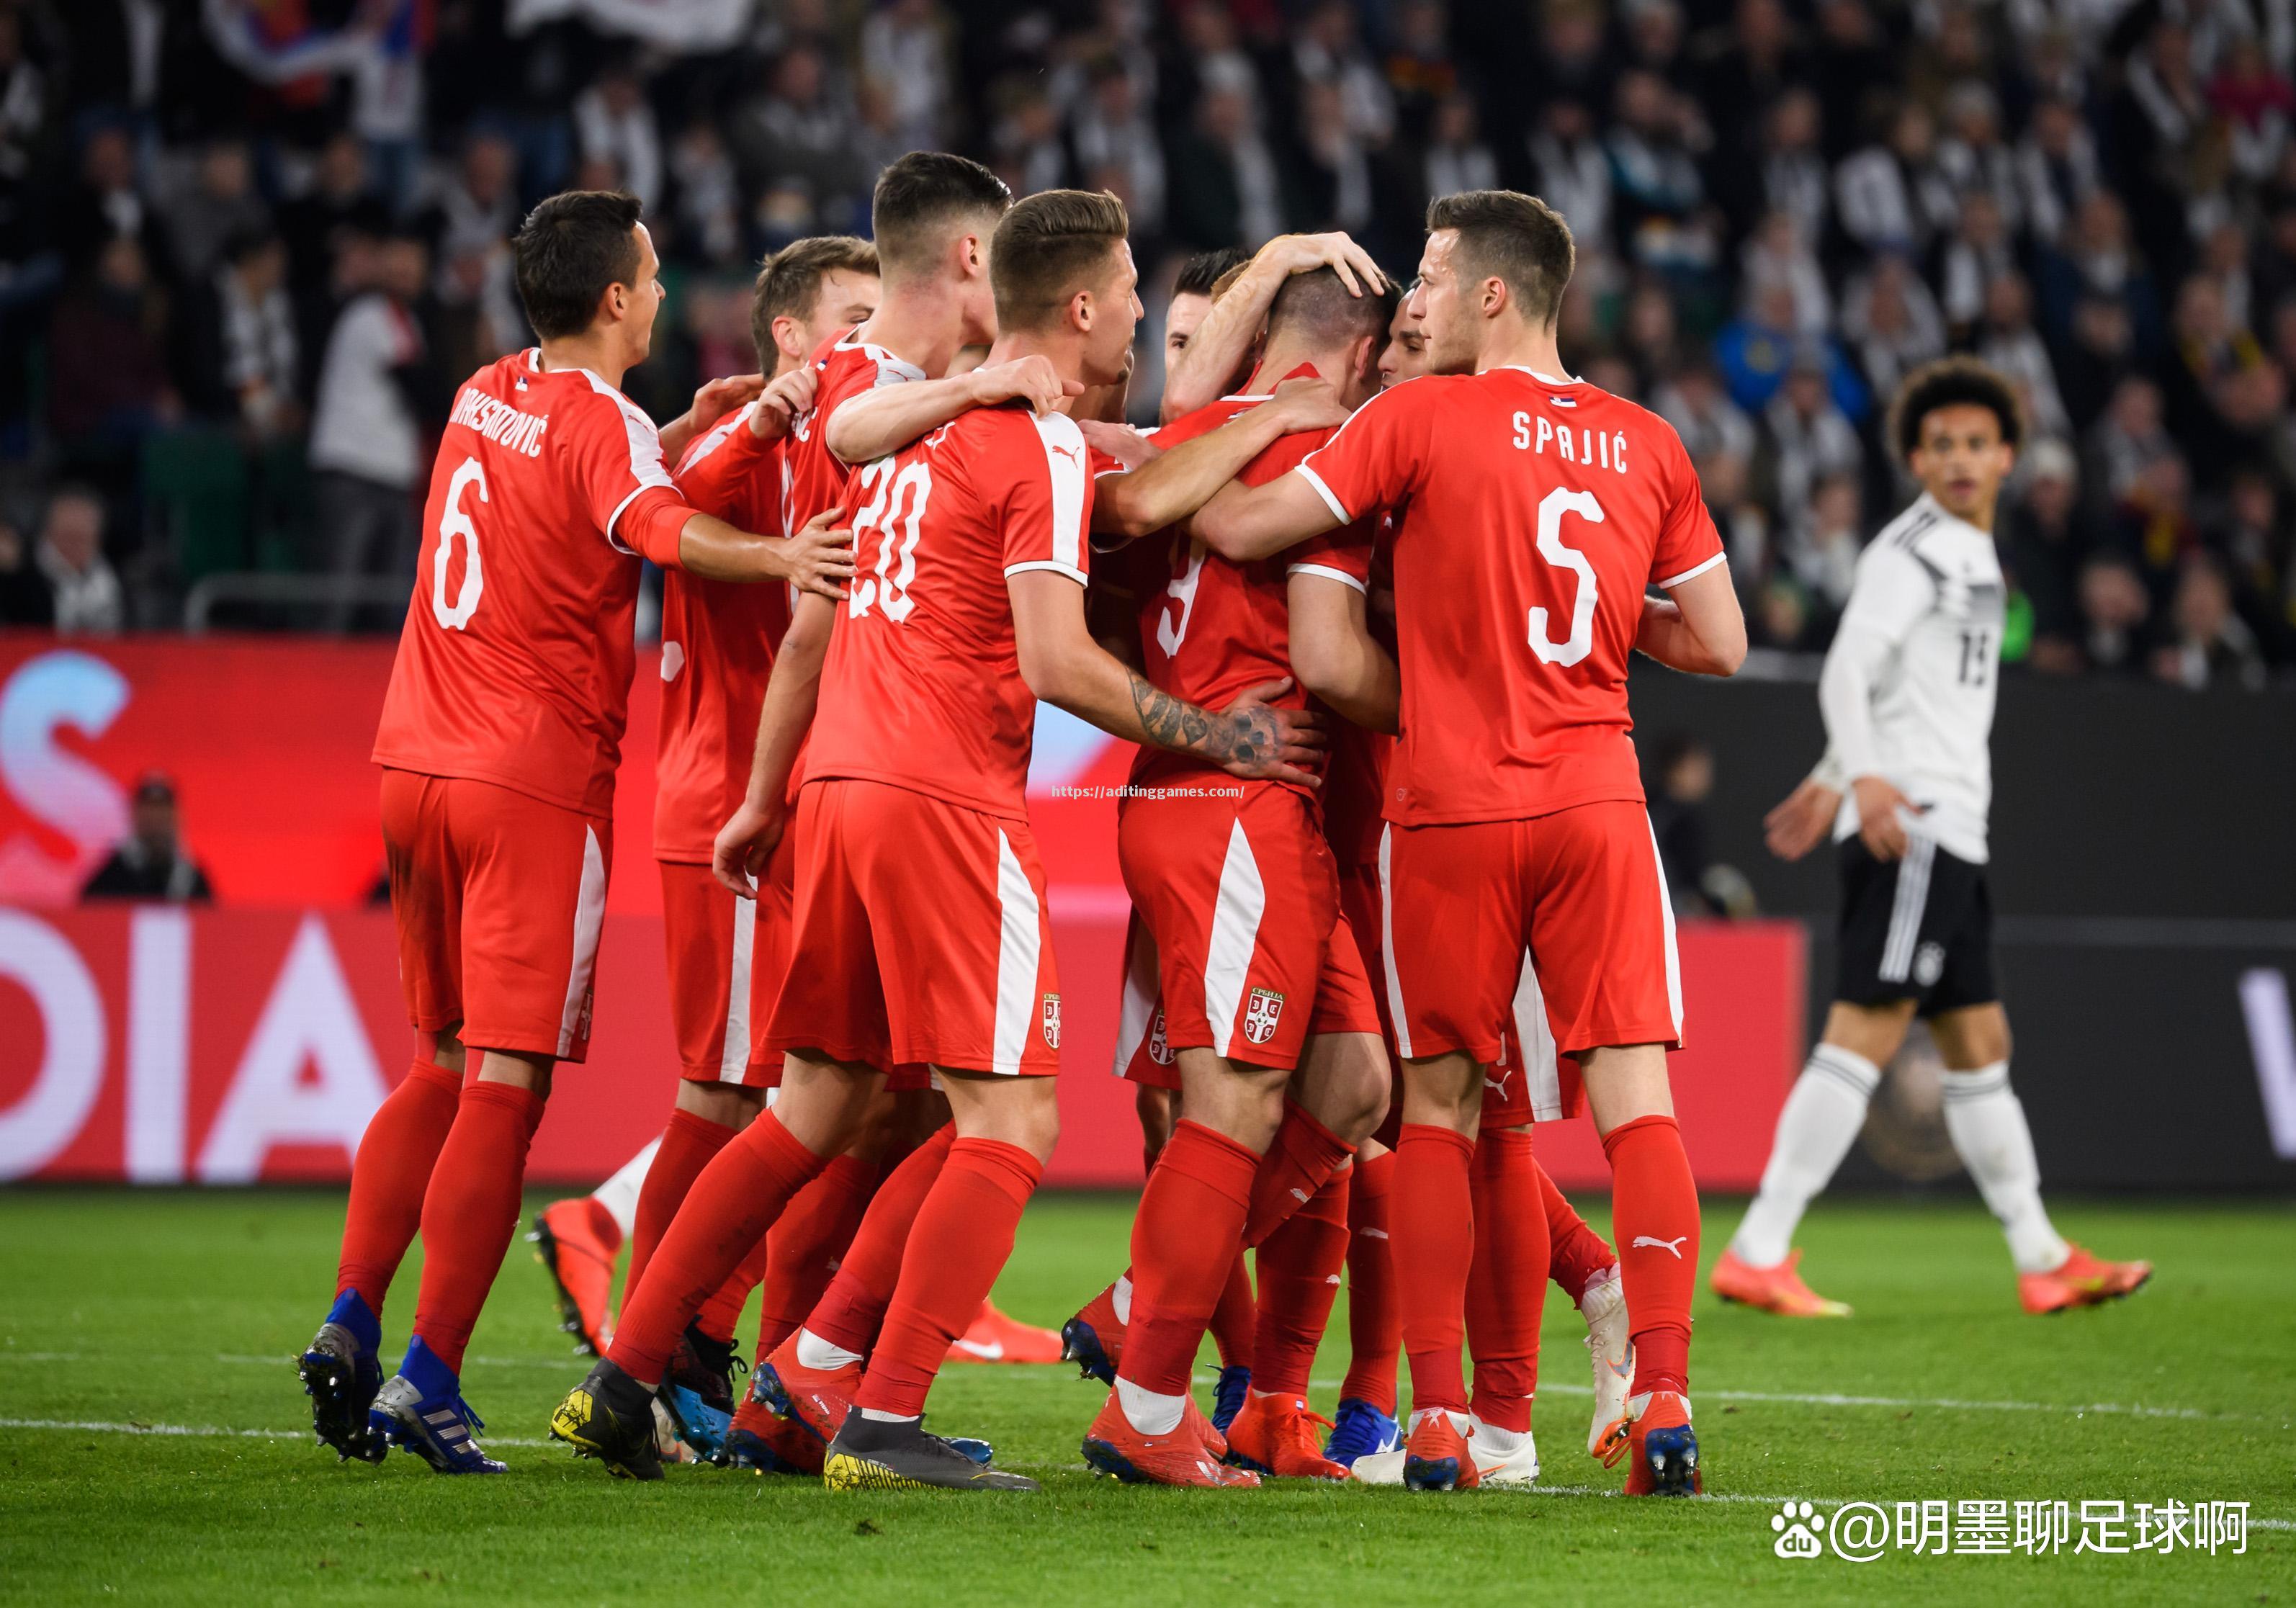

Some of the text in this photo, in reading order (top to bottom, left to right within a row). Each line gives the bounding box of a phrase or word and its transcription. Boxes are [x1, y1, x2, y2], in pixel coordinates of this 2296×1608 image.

[1512, 411, 1627, 474] SPAJIĆ
[433, 457, 488, 630] 6
[848, 454, 932, 624] 20
[1528, 487, 1605, 668] 5
